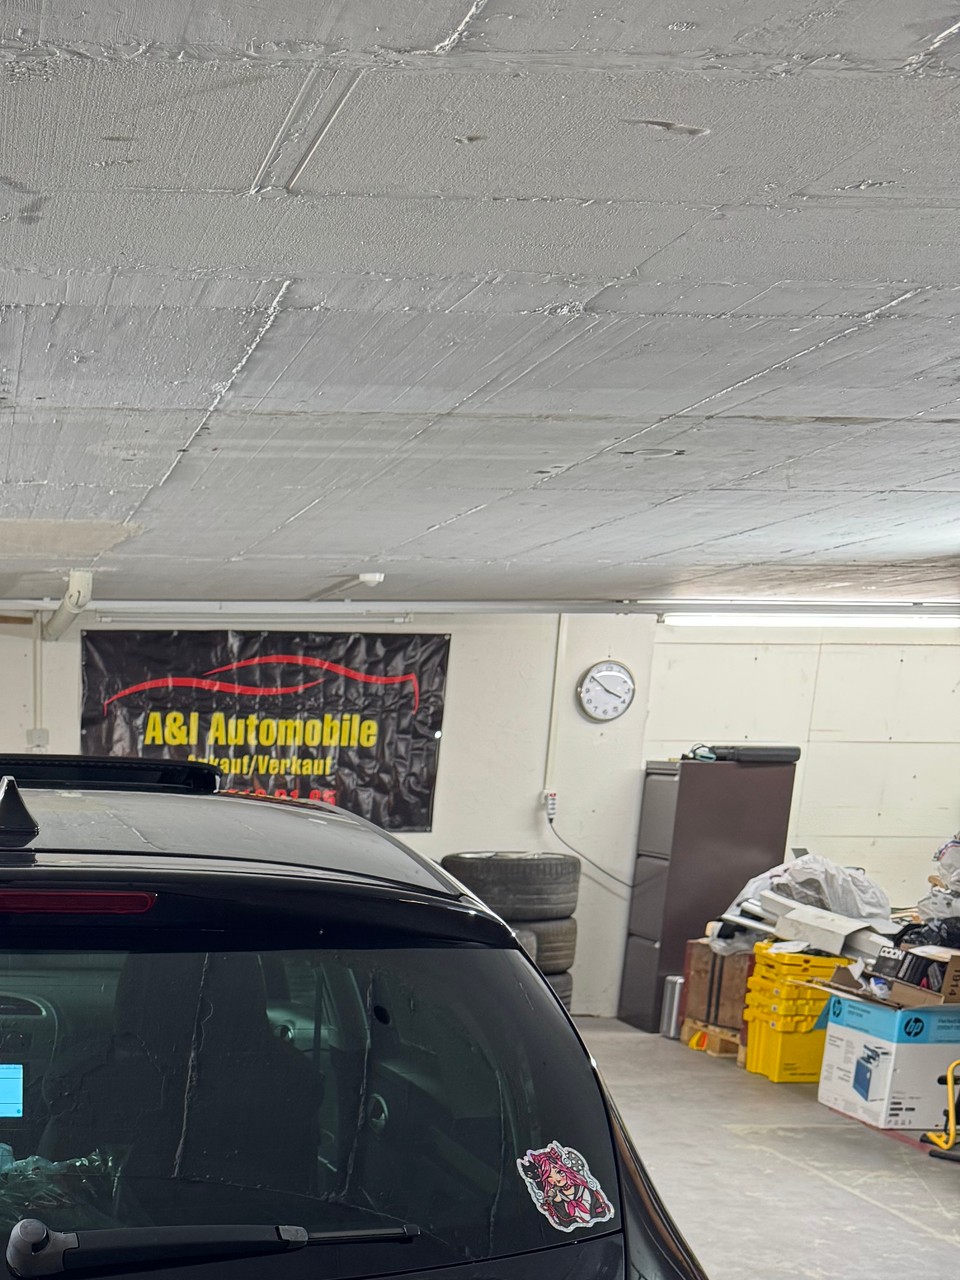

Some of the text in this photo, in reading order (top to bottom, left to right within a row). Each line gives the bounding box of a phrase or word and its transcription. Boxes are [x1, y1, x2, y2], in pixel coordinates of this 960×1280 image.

[143, 711, 379, 748] A&I Automobile
[187, 754, 333, 777] kauf/Verkauf
[904, 1017, 925, 1038] hp
